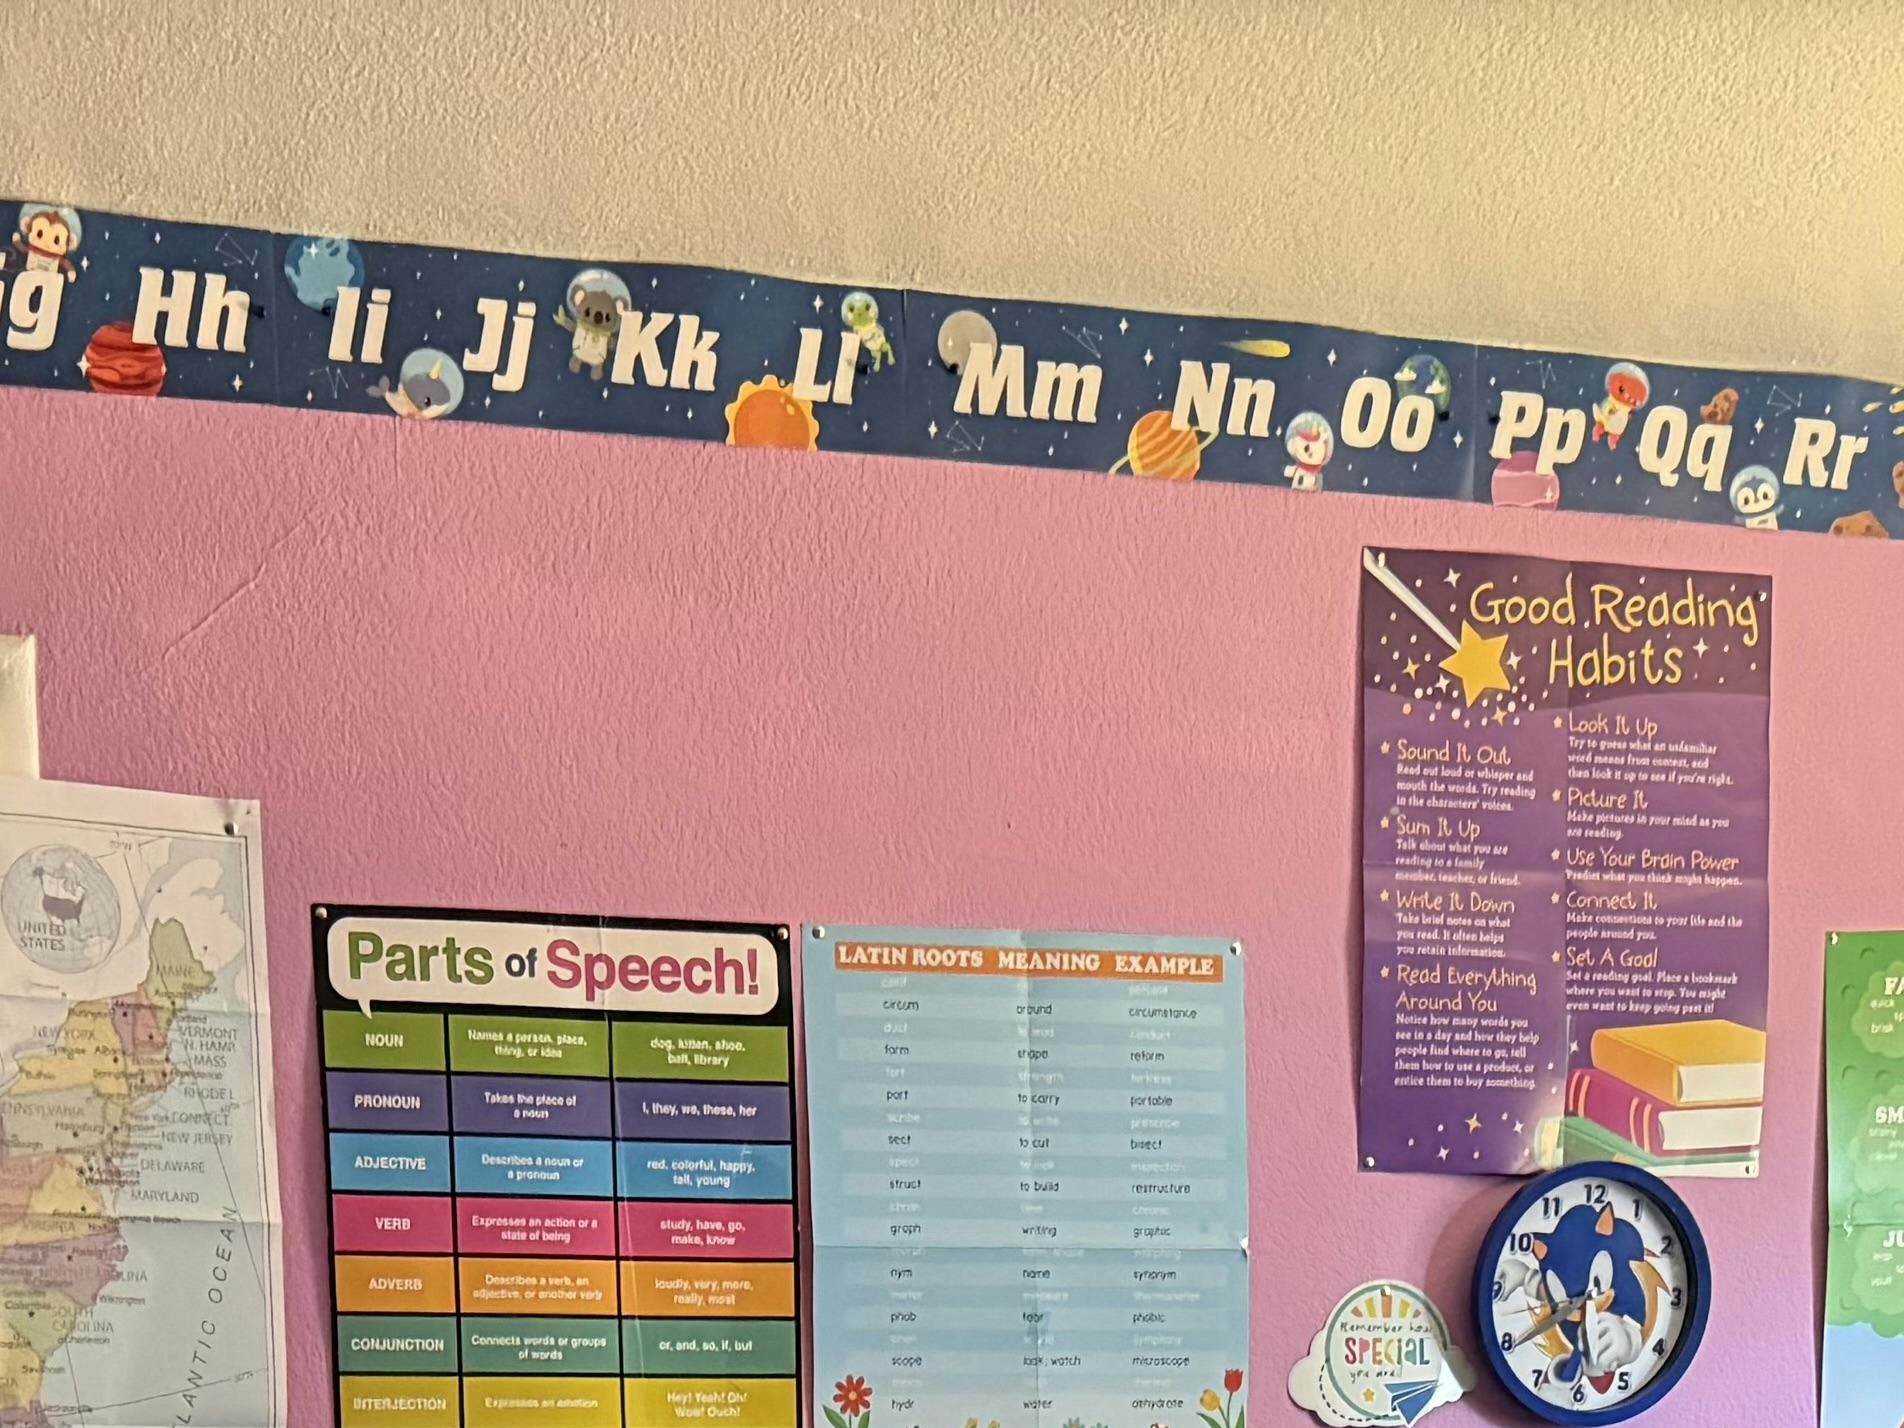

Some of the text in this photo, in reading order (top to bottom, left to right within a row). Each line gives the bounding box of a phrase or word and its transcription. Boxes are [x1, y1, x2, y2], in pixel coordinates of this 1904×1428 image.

[131, 268, 250, 355] Hh
[325, 277, 389, 366] Ii
[462, 299, 535, 389] Jj
[609, 308, 717, 391] Kk
[793, 329, 859, 405] Ll
[954, 343, 1103, 423] Mm
[1170, 360, 1276, 436] Nn
[1340, 377, 1435, 453] Oo
[1491, 391, 1585, 475] Pp
[1638, 406, 1731, 492] Qq
[1782, 418, 1867, 490] Rr
[1470, 572, 1759, 646] Good Reading
[1548, 633, 1683, 688] Habits
[1568, 714, 1658, 740] Look It Up
[348, 930, 759, 1001] Parts of Speech!
[839, 946, 1214, 975] LATIN ROOTS MEANING EXAMPLE
[365, 1033, 403, 1047] NOUN
[354, 1094, 420, 1110] PRONOUN
[354, 1155, 426, 1171] ADJECTIVE
[375, 1217, 410, 1231] VERB
[369, 1277, 422, 1291] ADVERB
[351, 1338, 444, 1353] CONJUNCTION
